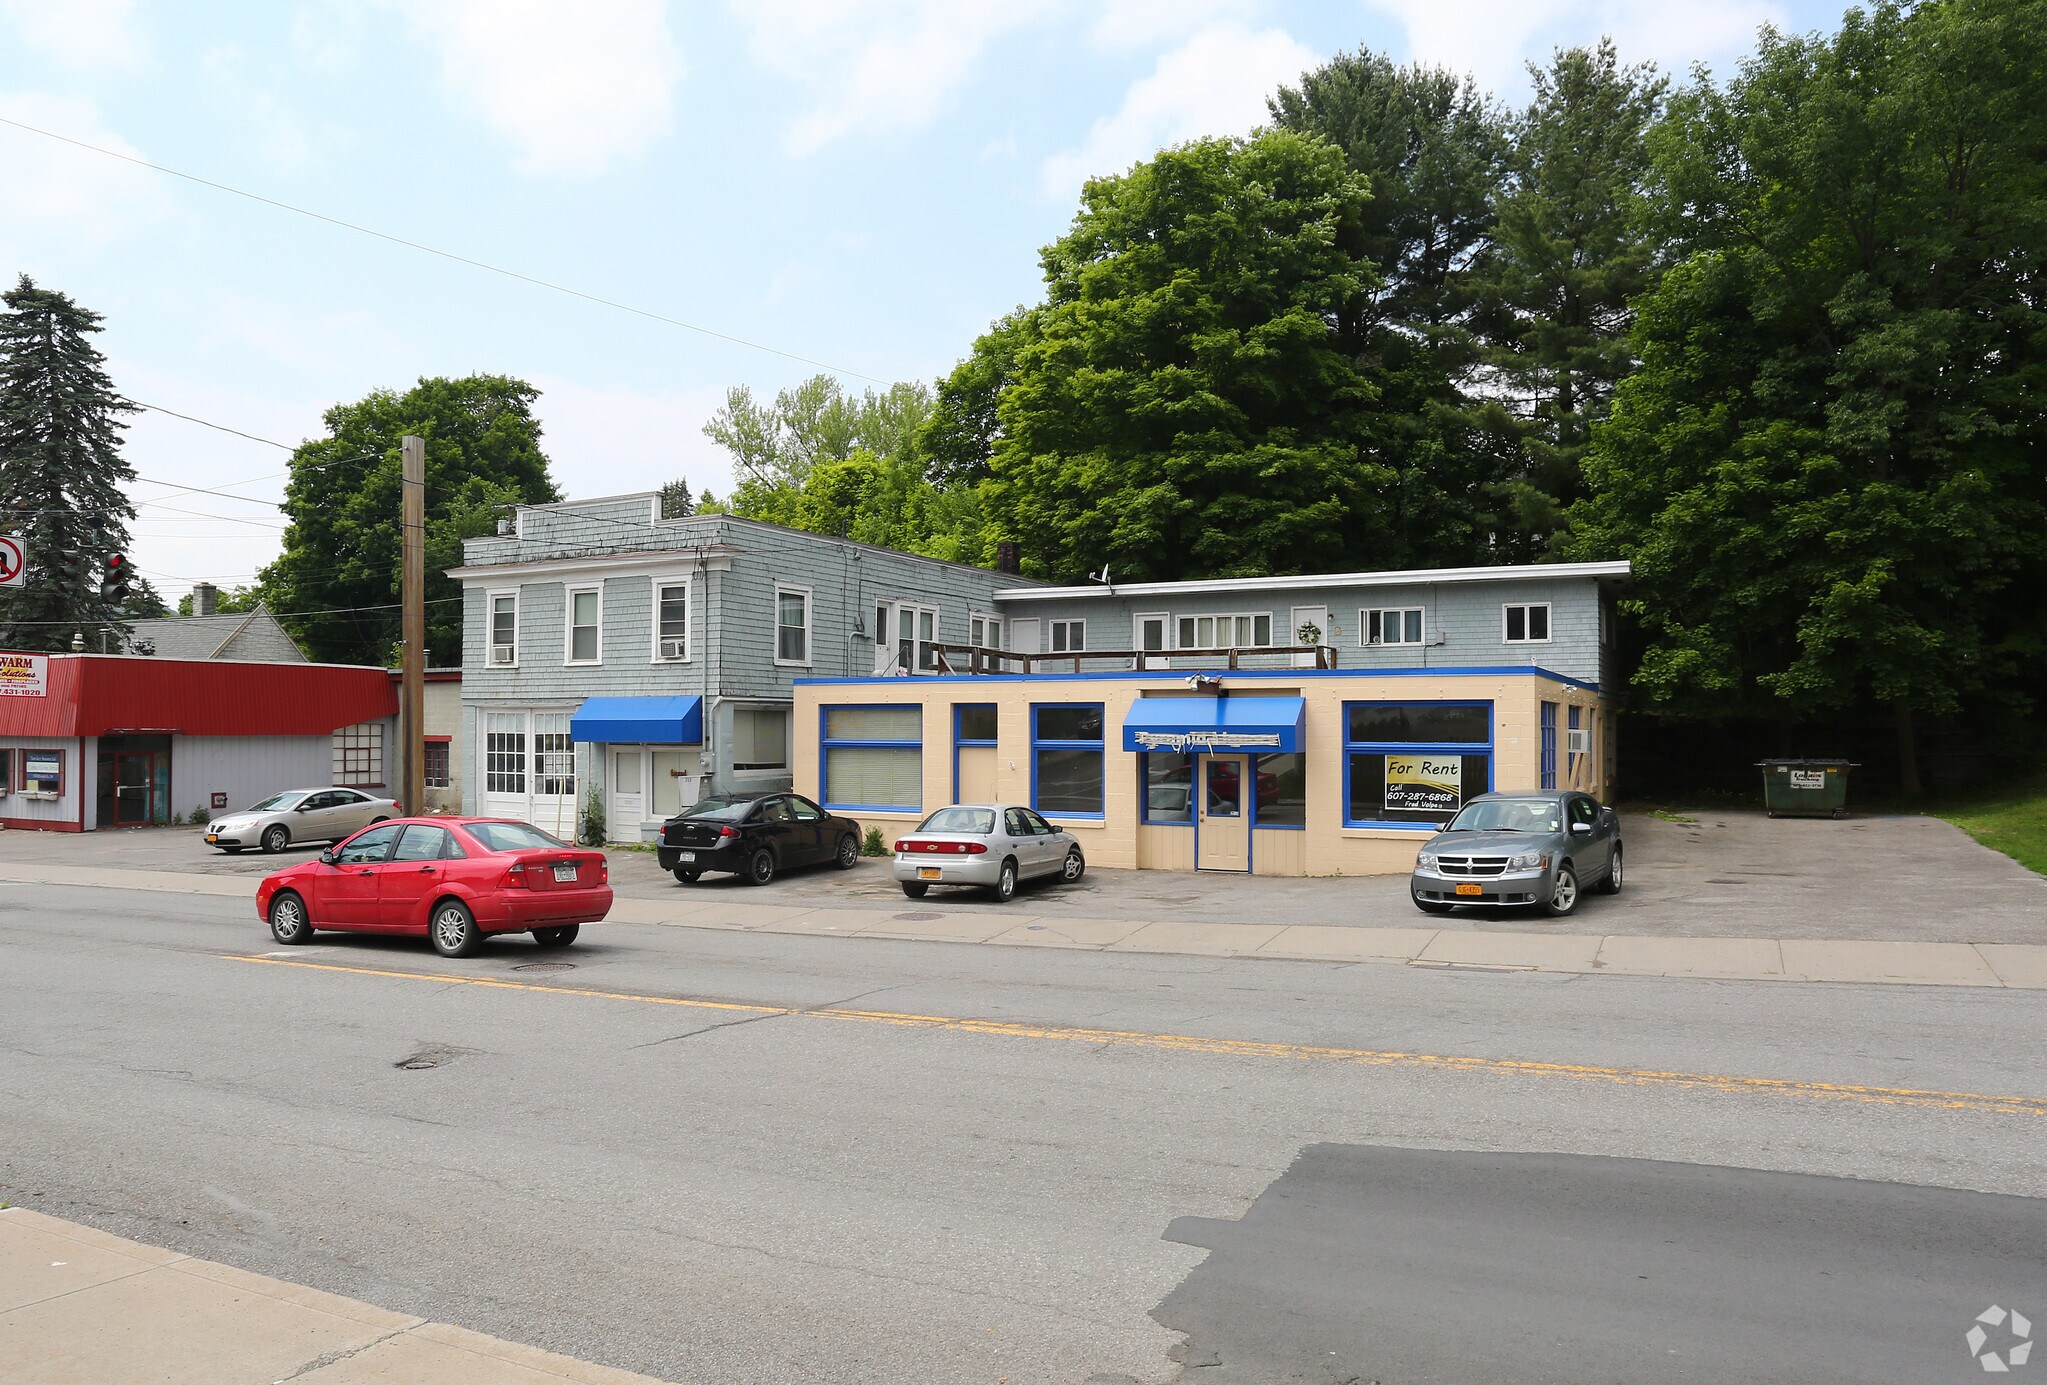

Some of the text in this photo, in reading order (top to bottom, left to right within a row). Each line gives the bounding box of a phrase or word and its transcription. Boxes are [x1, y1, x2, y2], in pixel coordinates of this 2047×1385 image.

[0, 668, 36, 678] olutions
[1388, 761, 1459, 775] For Rent
[1390, 784, 1403, 792] Call
[1387, 792, 1453, 801] 607-287-6868
